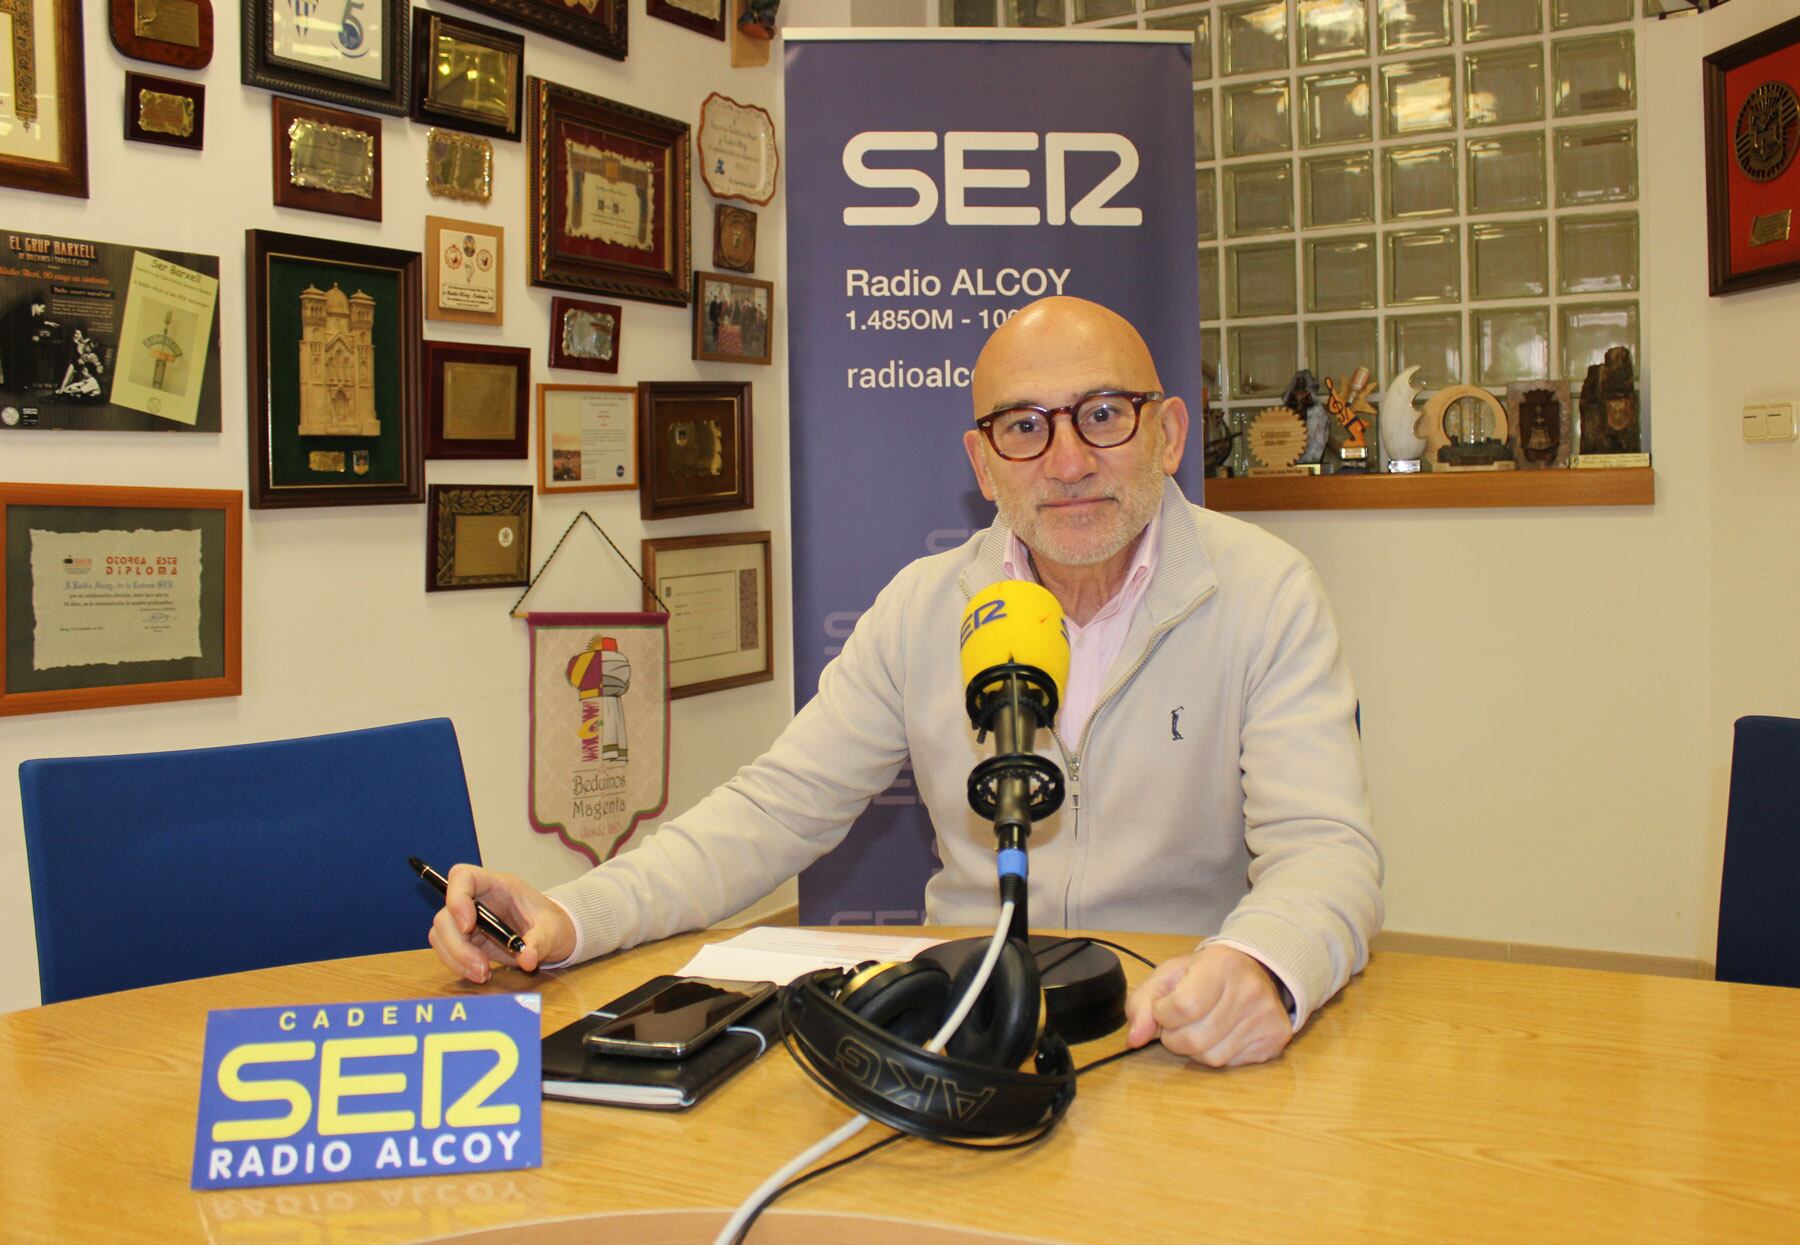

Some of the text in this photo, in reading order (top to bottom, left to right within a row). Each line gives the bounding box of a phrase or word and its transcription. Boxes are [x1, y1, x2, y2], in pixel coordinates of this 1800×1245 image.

[842, 131, 1143, 226] SER
[9, 235, 96, 259] EL GRUP BARXELL
[846, 268, 1071, 296] Radio ALCOY
[847, 360, 976, 388] radioalc
[105, 556, 178, 565] OTORGA ESTE
[960, 600, 1007, 650] ER
[572, 774, 626, 795] Beduinos
[572, 795, 626, 821] Magenta
[278, 1002, 468, 1032] CADENA
[211, 1030, 522, 1143] SER
[835, 1036, 996, 1123] AKG
[208, 1130, 521, 1181] RADIO ALCOY
